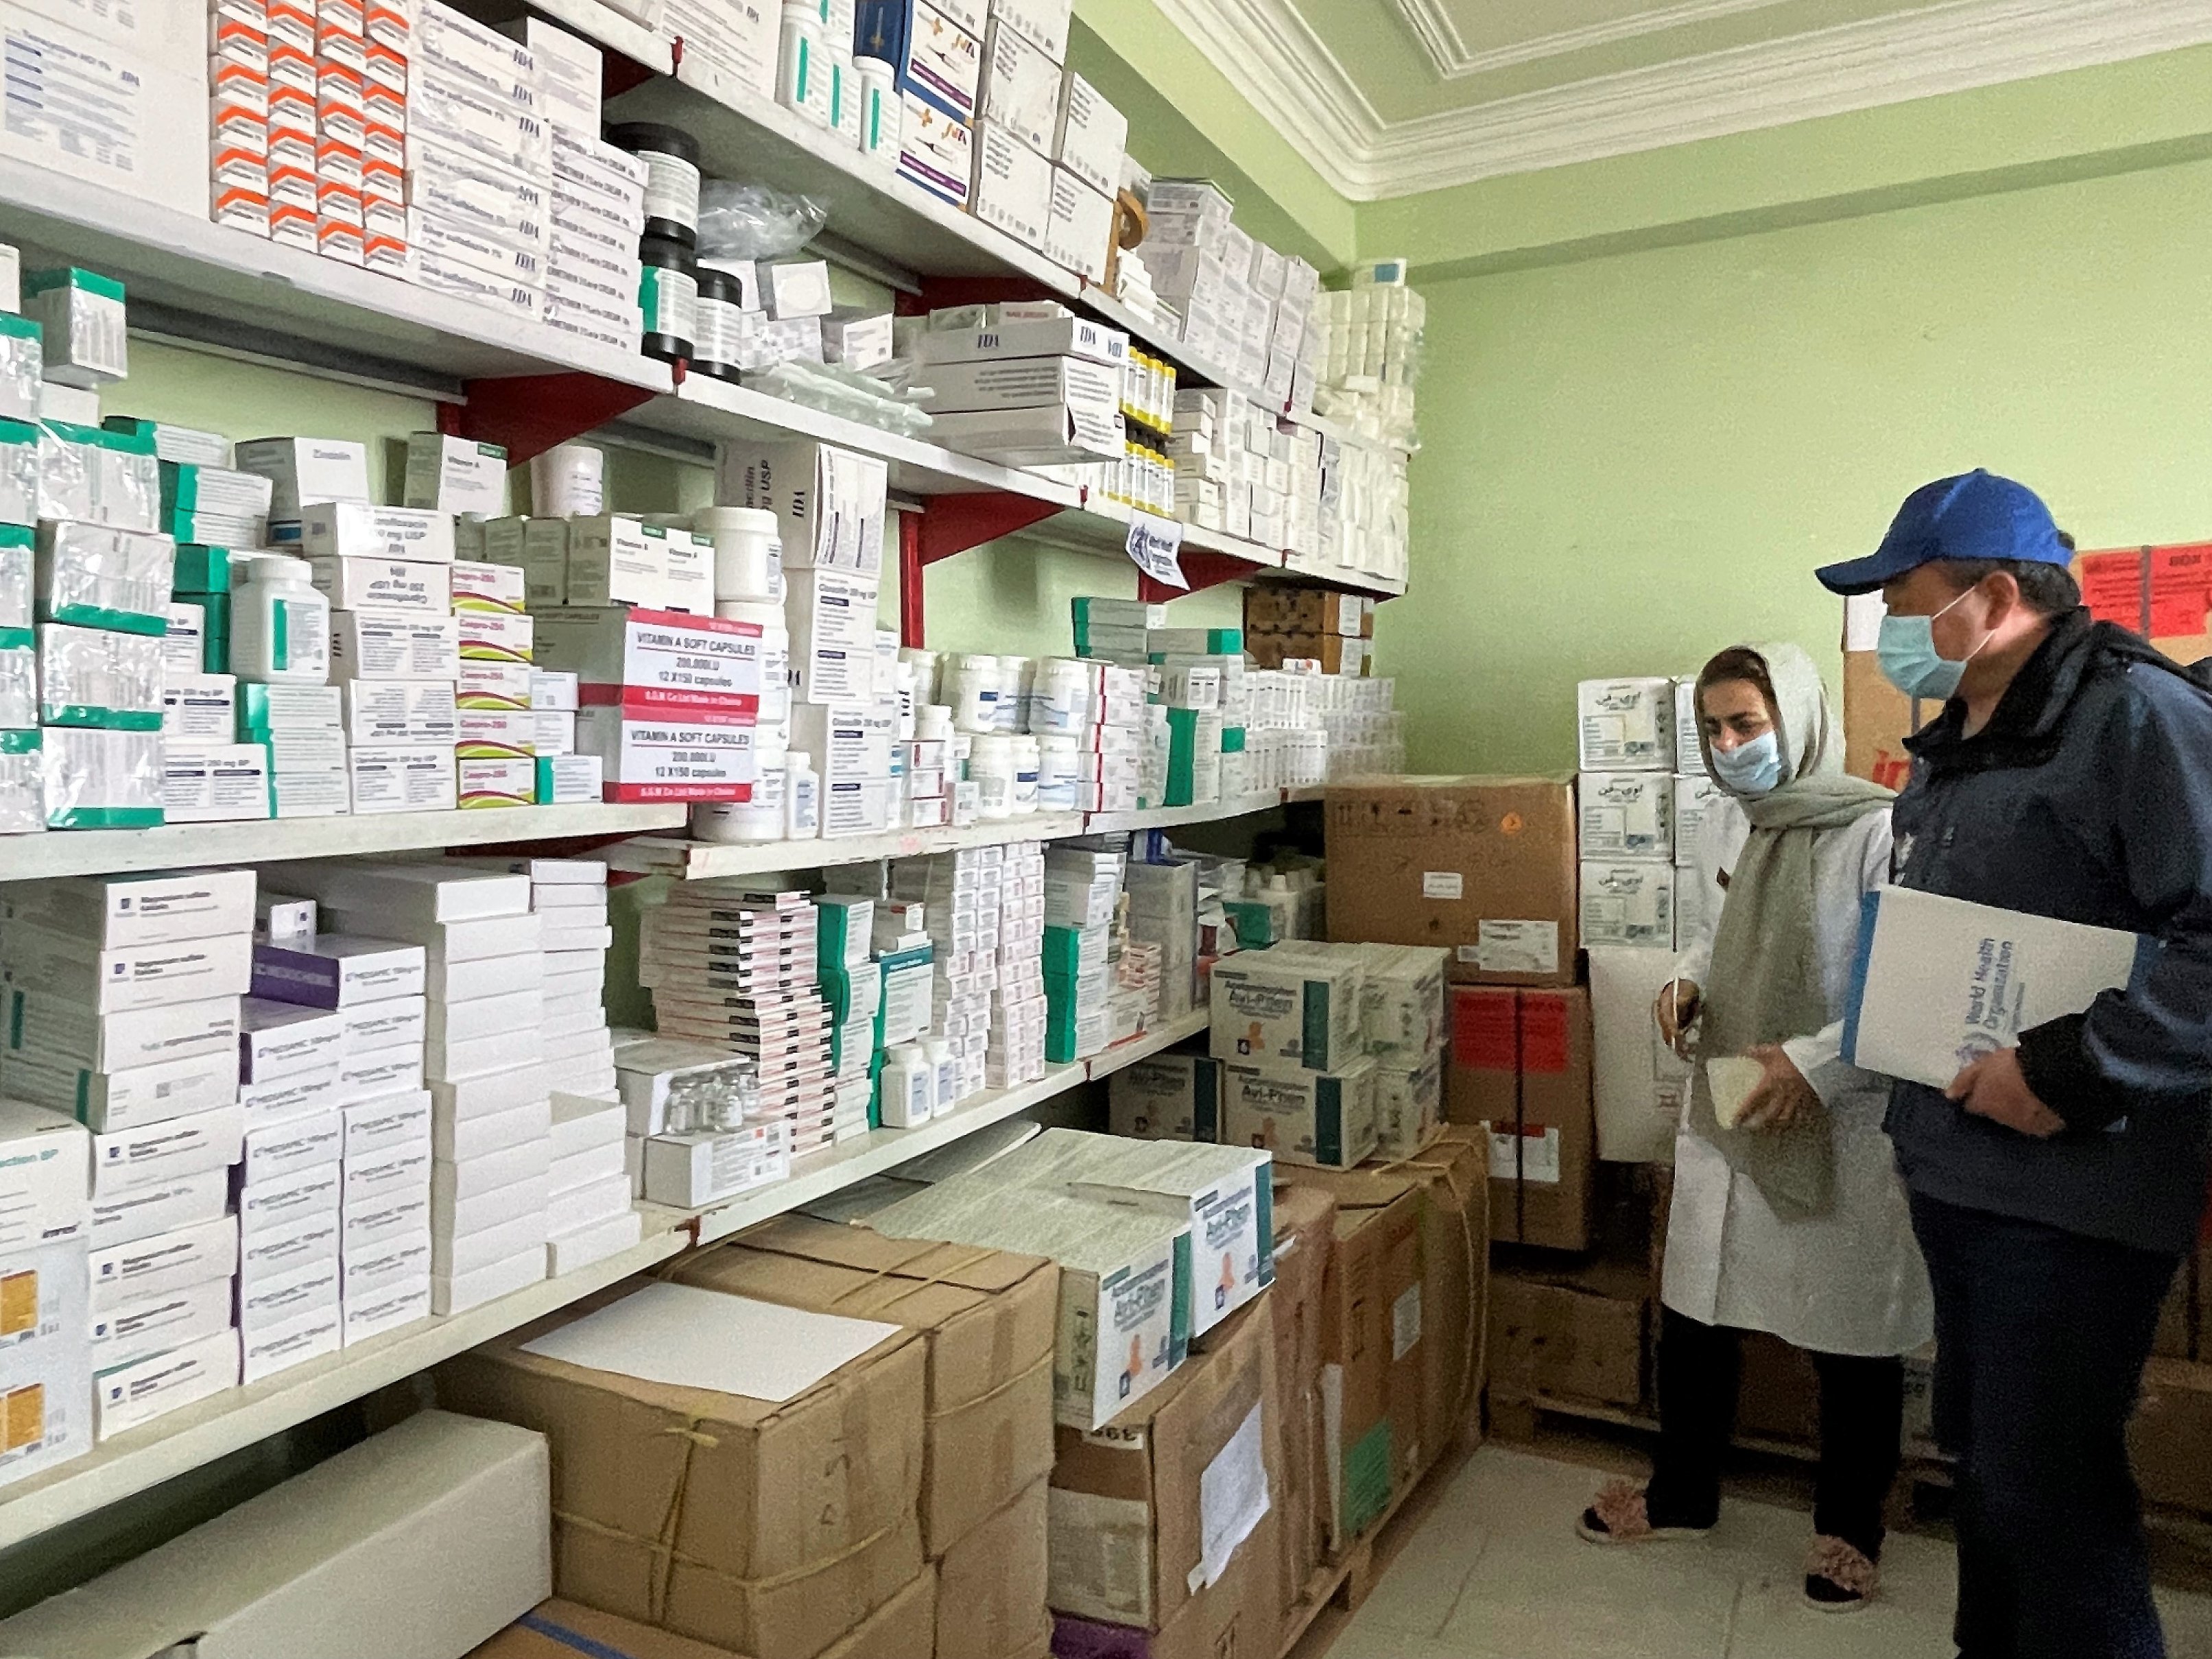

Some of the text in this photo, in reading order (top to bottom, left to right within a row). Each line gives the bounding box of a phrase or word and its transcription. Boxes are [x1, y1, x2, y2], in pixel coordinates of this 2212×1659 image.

[637, 631, 755, 656] VITAMIN A SOFT CAPSULES
[632, 730, 749, 745] VITAMIN A SOFT CAPSULES
[1964, 938, 1995, 1024] World Health
[1983, 941, 2013, 1029] Organization
